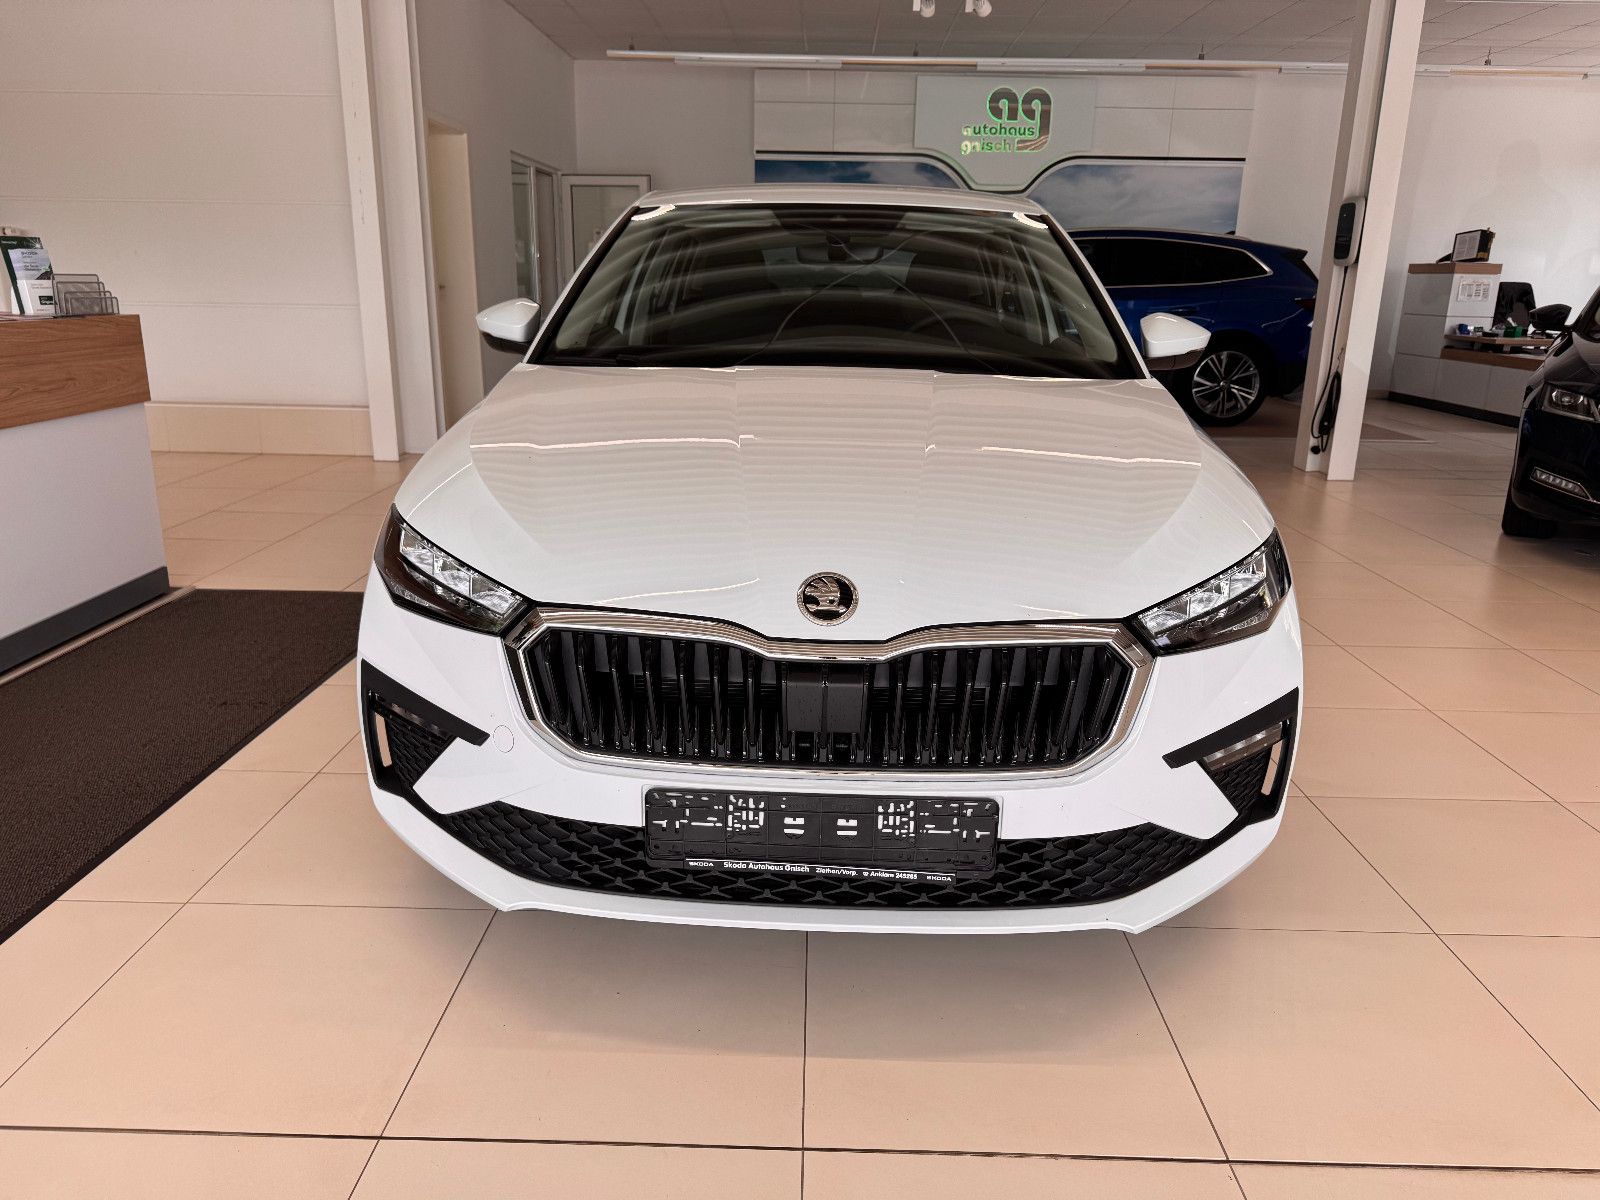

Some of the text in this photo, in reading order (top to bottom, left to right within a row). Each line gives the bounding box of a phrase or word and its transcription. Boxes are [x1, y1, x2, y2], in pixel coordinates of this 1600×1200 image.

[963, 122, 1035, 137] autohaus
[961, 139, 1012, 155] gnisch
[723, 861, 747, 869] Skoda
[748, 862, 783, 871] Autohaus
[784, 865, 810, 873] Gnisch
